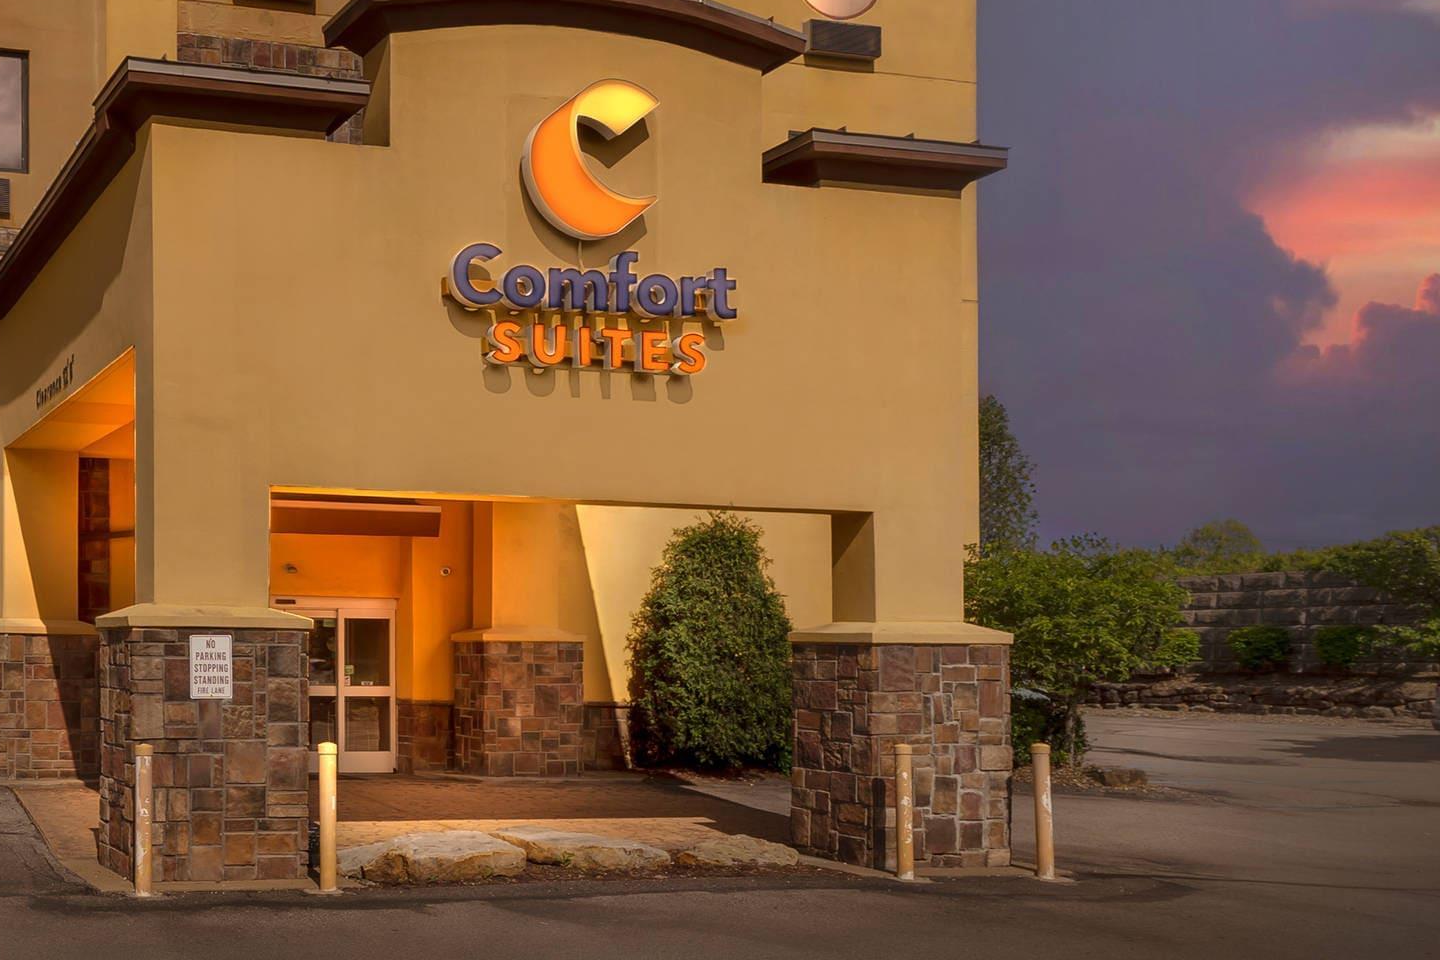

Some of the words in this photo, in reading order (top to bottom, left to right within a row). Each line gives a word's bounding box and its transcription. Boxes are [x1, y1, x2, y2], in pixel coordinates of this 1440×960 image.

[449, 241, 738, 320] Comfort
[486, 320, 706, 375] SUITES
[206, 640, 216, 648] NO
[195, 652, 227, 660] PARKING
[193, 664, 229, 672] STOPPING
[193, 676, 229, 684] STANDING
